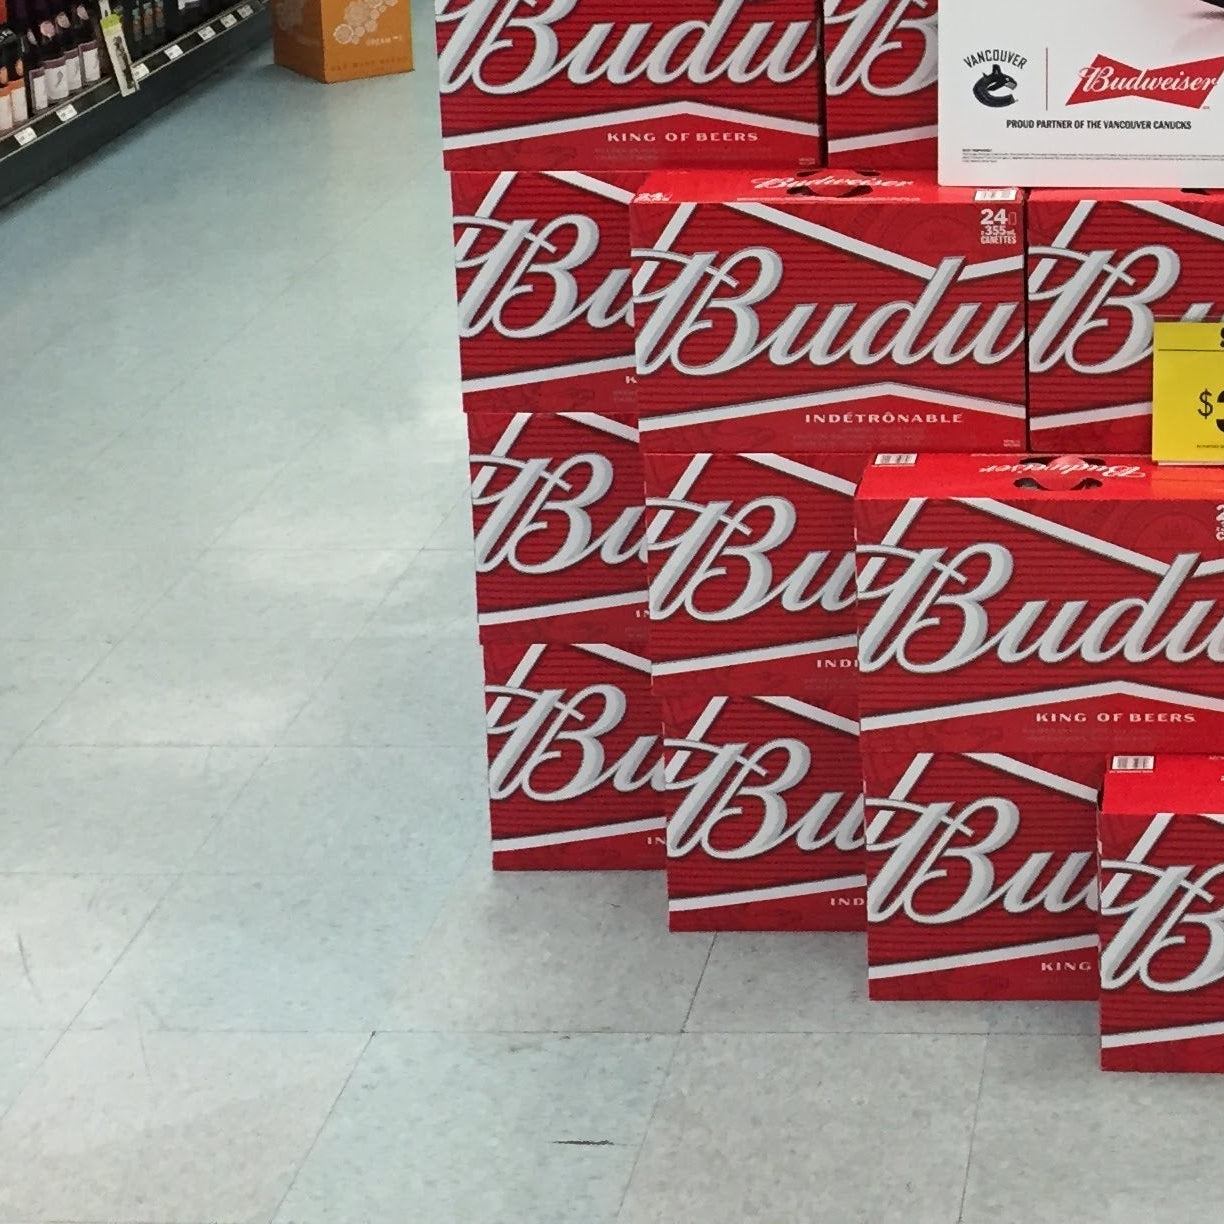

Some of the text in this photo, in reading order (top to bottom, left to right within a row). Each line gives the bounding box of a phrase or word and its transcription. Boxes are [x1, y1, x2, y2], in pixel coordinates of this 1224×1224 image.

[963, 49, 1028, 69] VANCOUVER
[1078, 66, 1219, 93] Budweiser
[1006, 119, 1192, 130] PROUD PARTNER OF THE VANCOUVER CANUCKS
[607, 132, 758, 142] KING OF BEERS
[751, 175, 914, 190] Budweiser
[981, 208, 1008, 225] 24
[805, 411, 963, 424] INDÉTRÔNABLE
[1036, 713, 1195, 723] KING OF BEERS
[1041, 962, 1092, 971] KING
